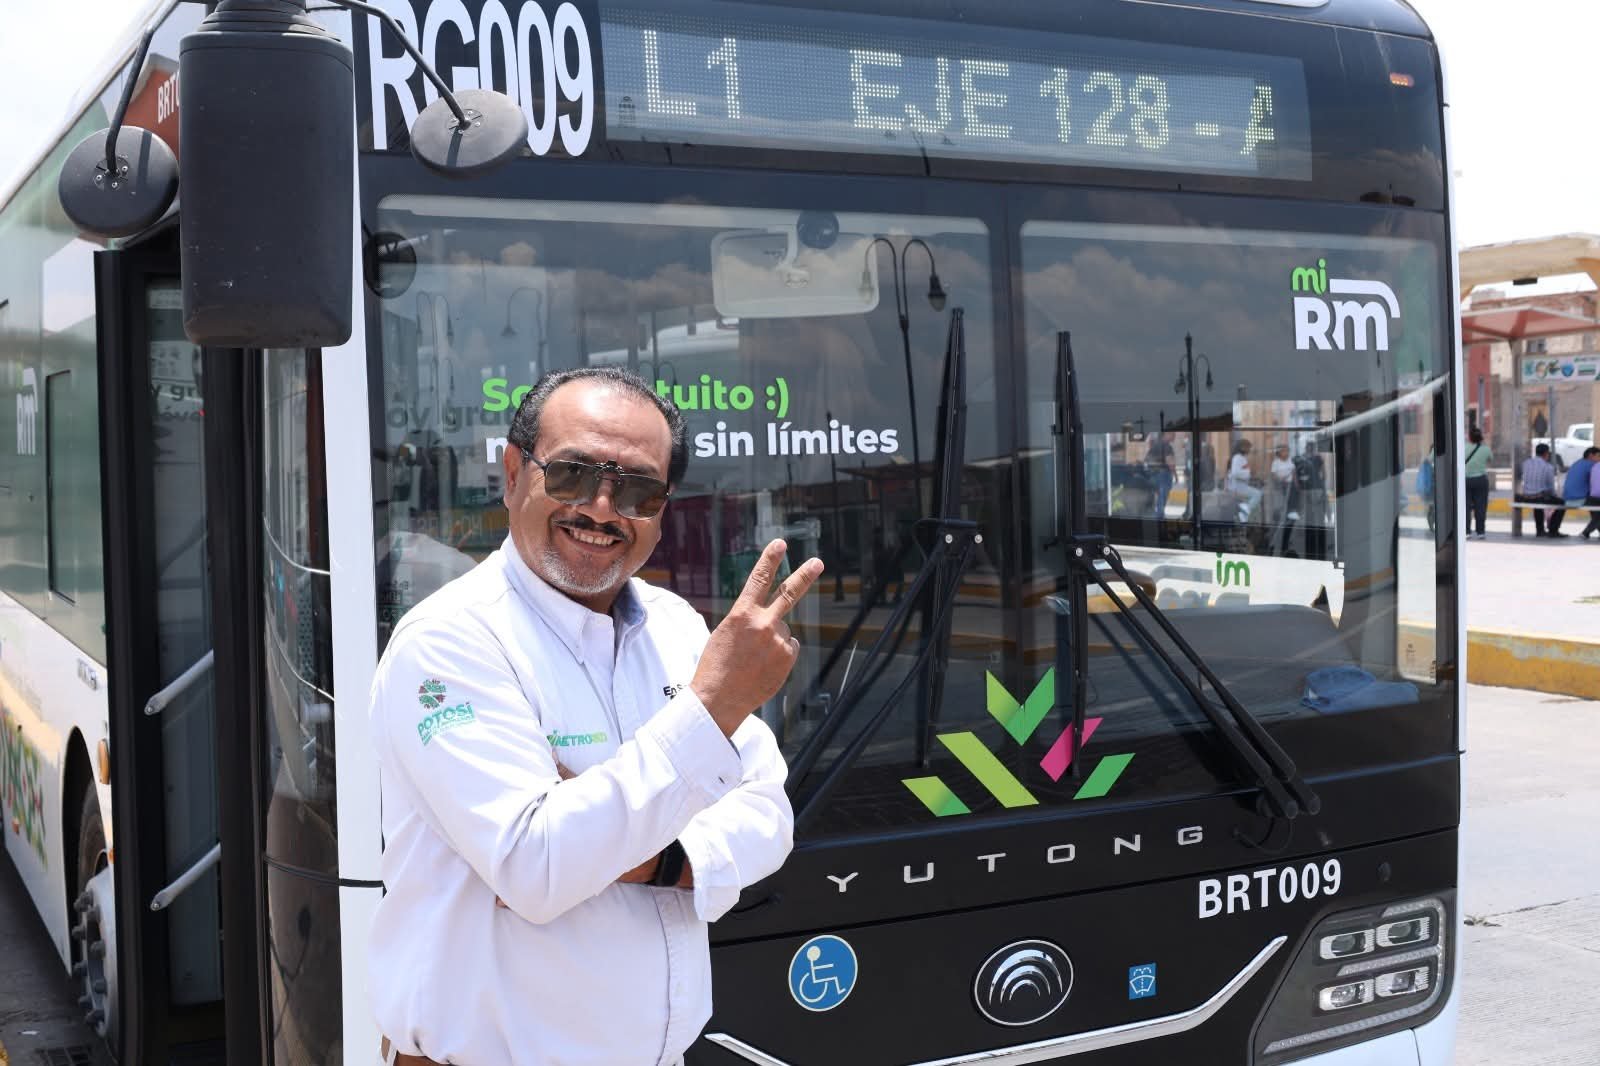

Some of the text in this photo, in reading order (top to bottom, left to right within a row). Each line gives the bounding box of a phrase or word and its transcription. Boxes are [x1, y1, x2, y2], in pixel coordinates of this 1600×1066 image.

[366, 0, 594, 157] RG009
[644, 29, 741, 119] L1
[849, 48, 1012, 138] EJE
[1039, 66, 1170, 150] 128
[1292, 258, 1327, 295] mi
[656, 374, 754, 411] tuito
[694, 419, 899, 458] sin límites
[826, 825, 1204, 893] YUTONG
[1198, 858, 1342, 919] BRT009
